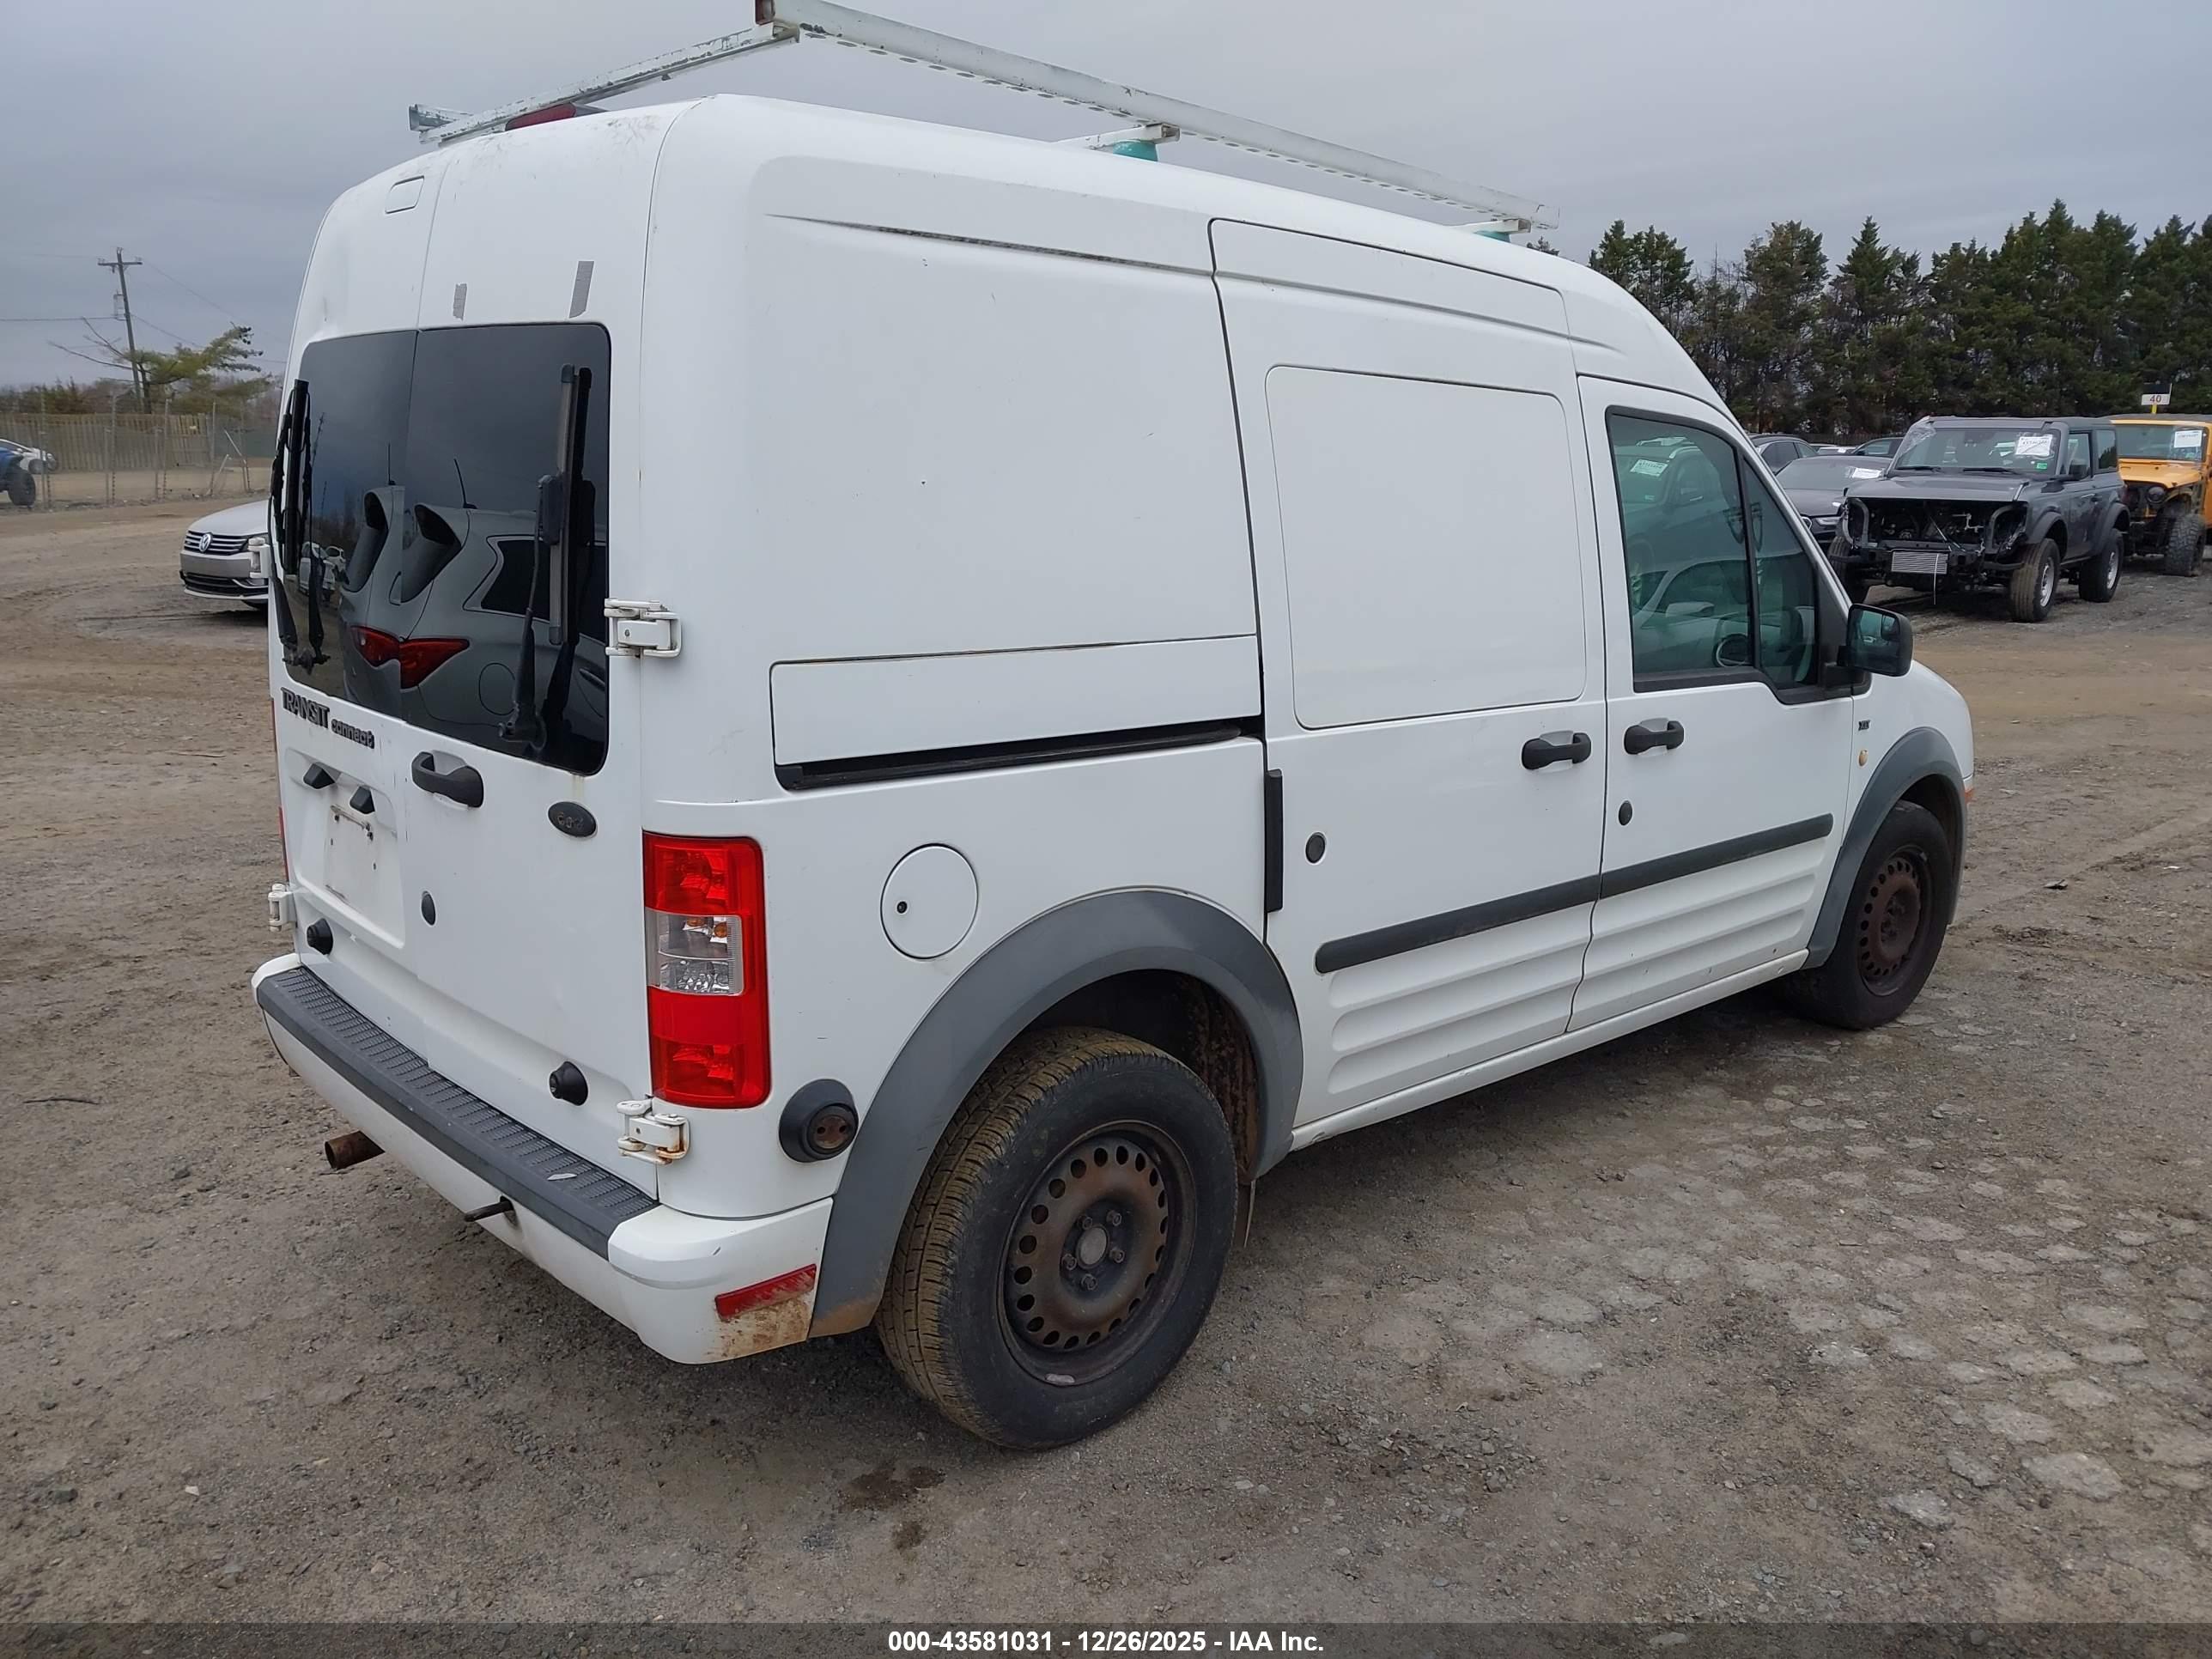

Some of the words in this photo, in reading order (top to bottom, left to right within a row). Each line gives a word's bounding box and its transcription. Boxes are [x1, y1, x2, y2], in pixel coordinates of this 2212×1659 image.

[2149, 394, 2162, 404] 40
[280, 686, 331, 729] TRANSIT
[331, 719, 375, 750] connect
